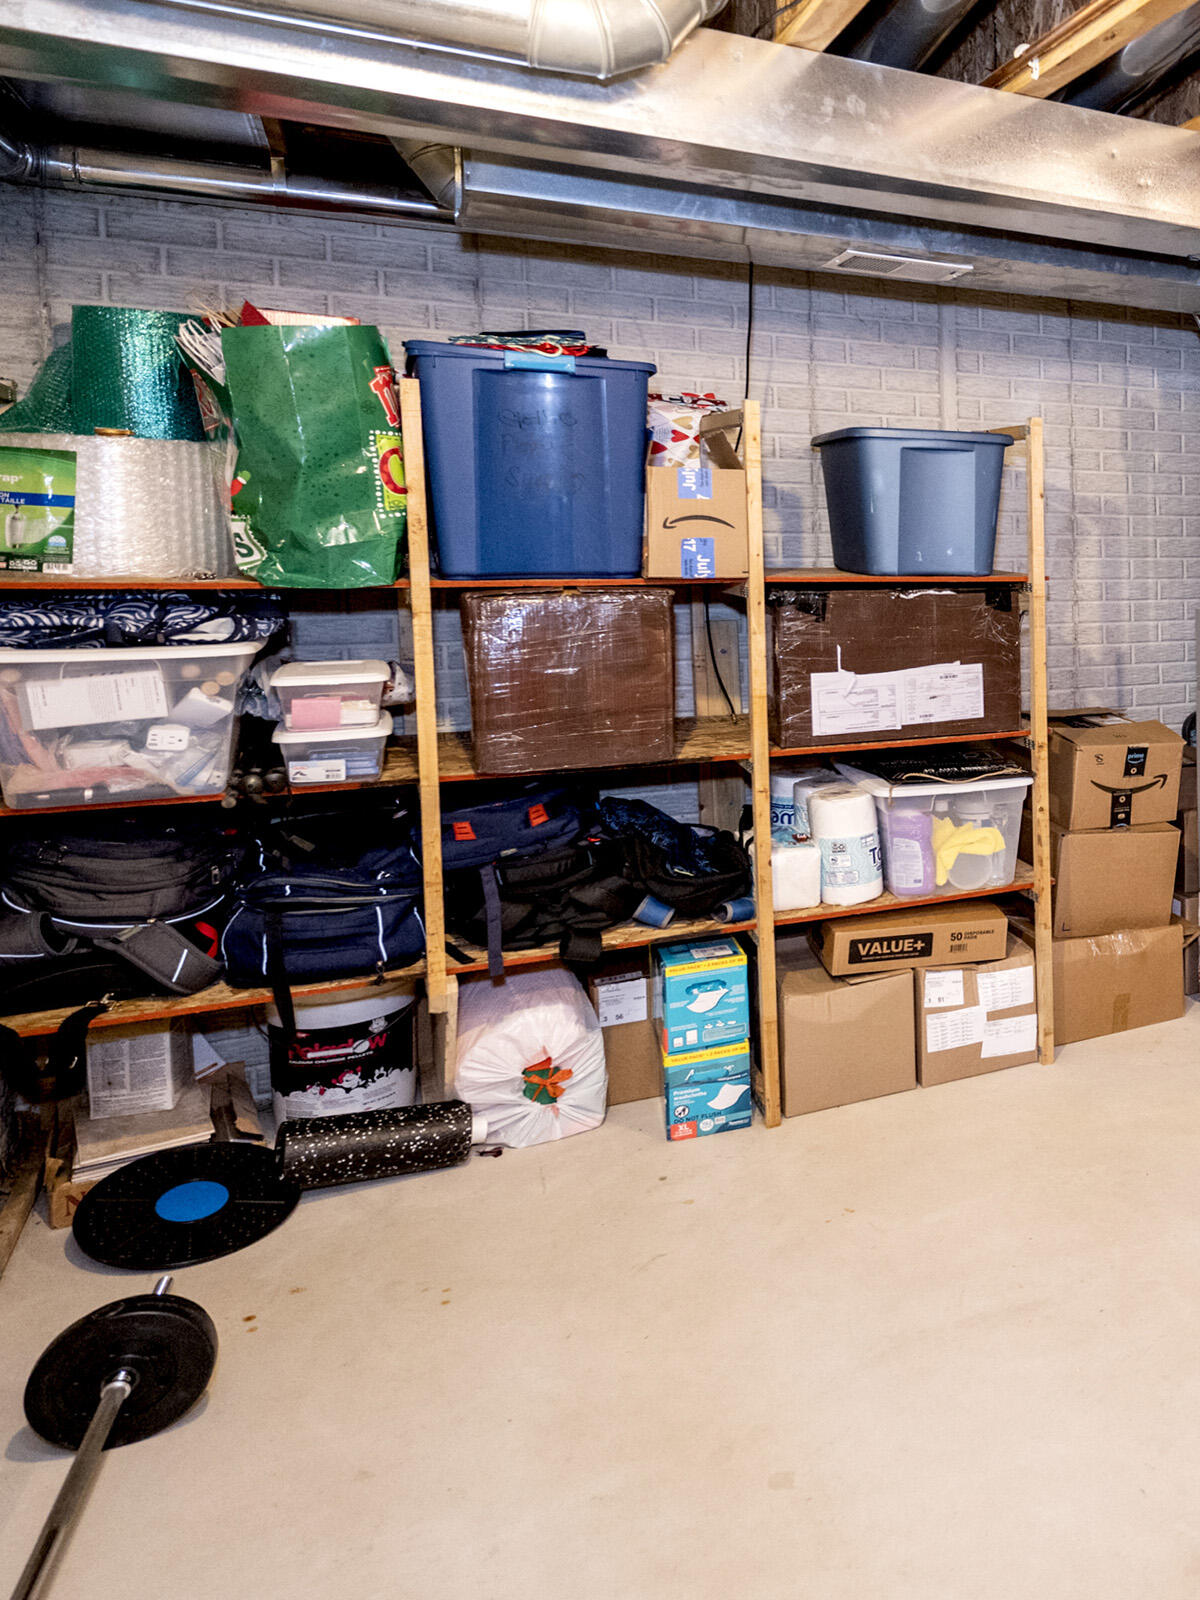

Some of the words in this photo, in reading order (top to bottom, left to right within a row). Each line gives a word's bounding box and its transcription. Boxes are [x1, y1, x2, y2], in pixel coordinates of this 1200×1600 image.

[1127, 752, 1145, 760] prime
[950, 932, 963, 941] 50
[858, 938, 926, 956] VALUE+
[701, 1111, 722, 1119] FLUSH
